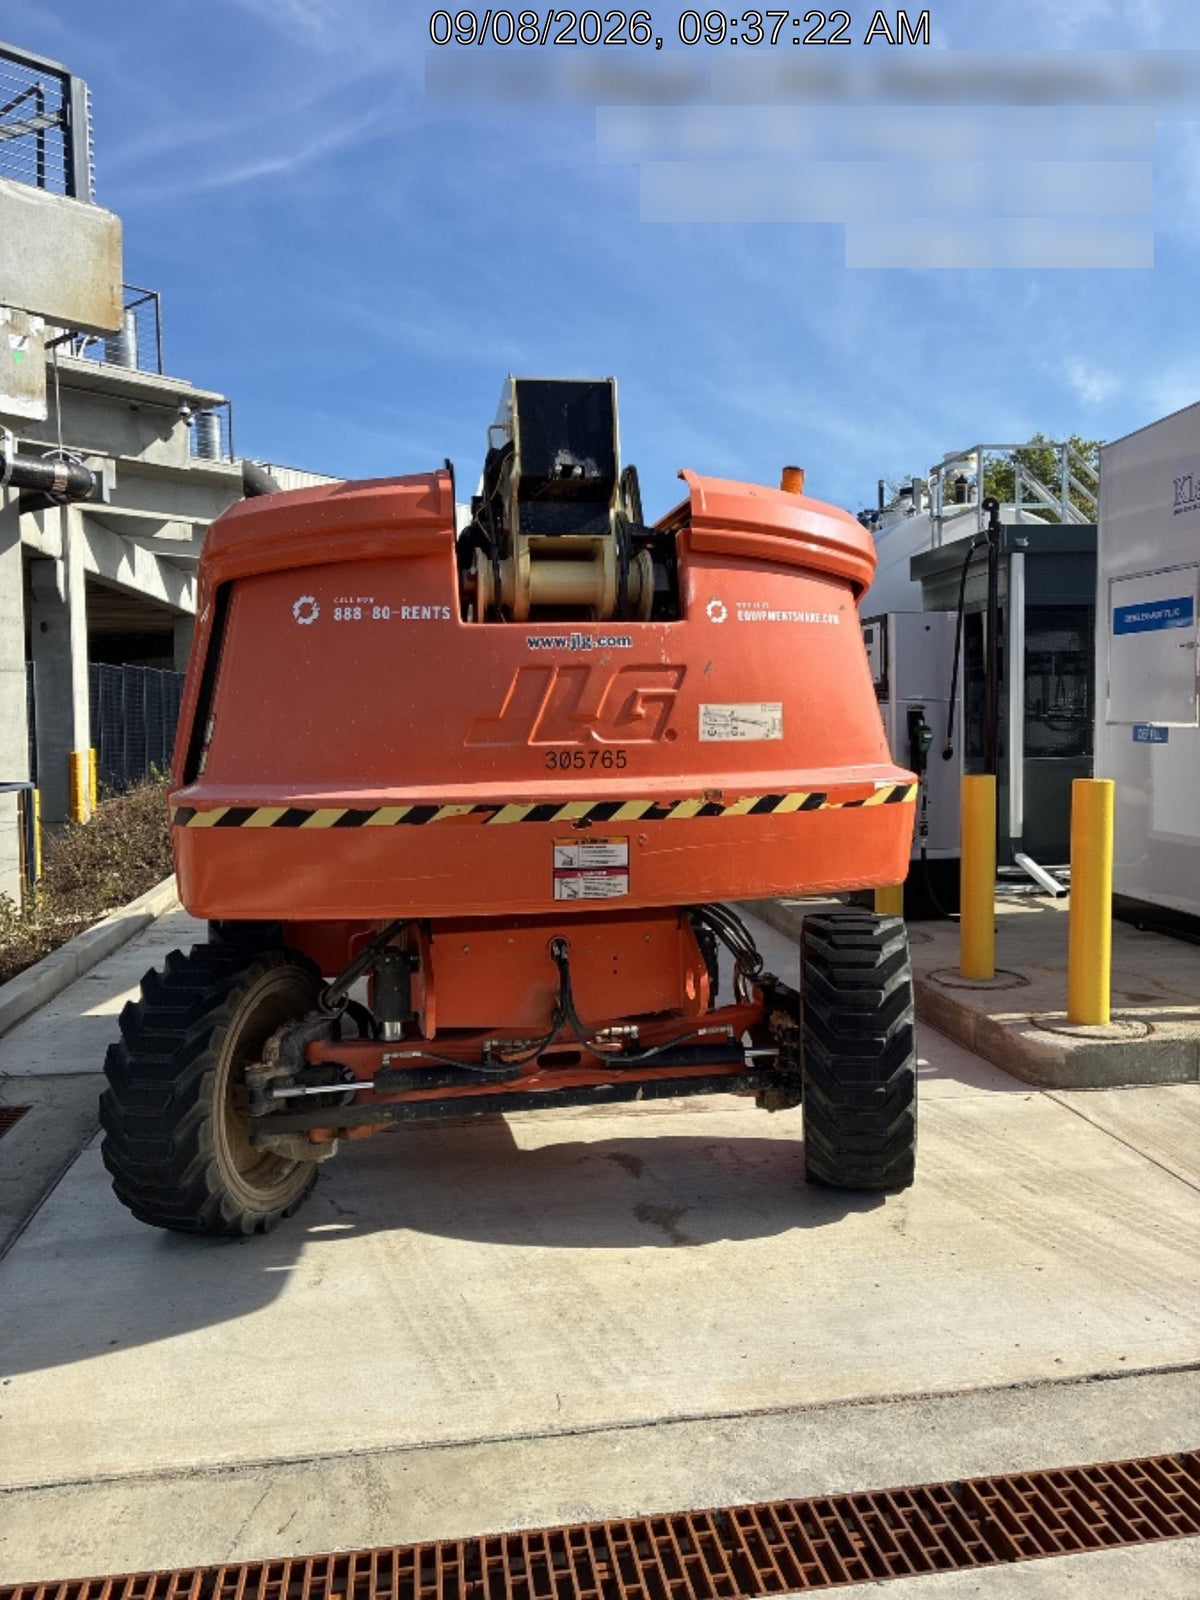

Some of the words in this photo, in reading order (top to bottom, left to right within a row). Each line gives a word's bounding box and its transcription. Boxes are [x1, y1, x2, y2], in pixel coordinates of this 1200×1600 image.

[1173, 474, 1200, 507] Kl
[526, 632, 634, 651] www.jlg.com
[463, 664, 687, 746] JLG
[544, 750, 627, 769] 305765
